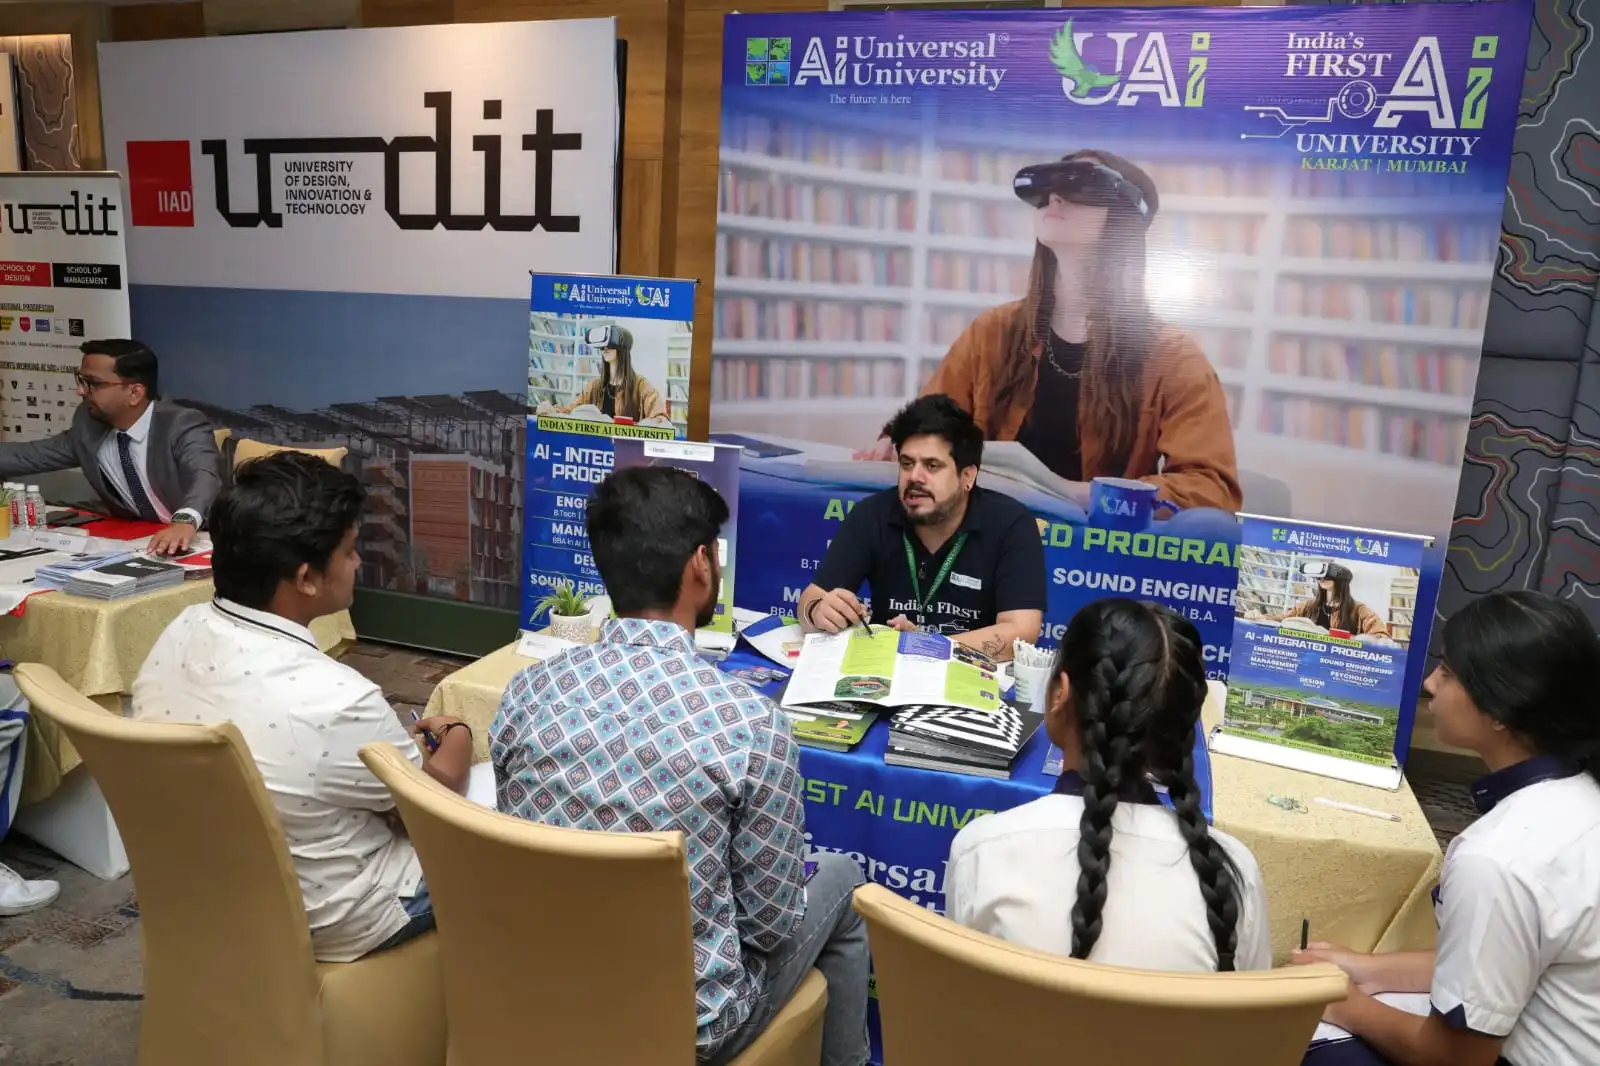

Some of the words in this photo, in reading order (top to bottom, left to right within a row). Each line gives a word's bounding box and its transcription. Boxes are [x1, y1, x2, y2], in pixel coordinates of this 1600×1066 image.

[853, 33, 997, 60] Universal
[1287, 32, 1365, 50] India's
[1284, 52, 1392, 78] FIRST
[853, 61, 1008, 92] University
[829, 93, 846, 104] The
[849, 93, 878, 105] future
[881, 94, 889, 104] is
[892, 94, 912, 105] here
[1296, 133, 1481, 156] UNIVERSITY
[284, 161, 353, 173] UNIVERSITY
[1301, 157, 1373, 171] KARJAT
[1386, 160, 1468, 173] MUMBAI
[284, 175, 300, 187] OF
[303, 175, 350, 188] DESIGN,
[158, 191, 191, 212] IIAD
[285, 189, 360, 201] INNOVATION
[363, 189, 372, 201] &
[286, 203, 366, 215] TECHNOLOGY
[66, 266, 92, 274] SCHOOL
[4, 274, 32, 282] DESIGN
[63, 276, 109, 285] MANAGEMENT
[587, 285, 631, 295] Universal
[587, 294, 634, 307] University
[540, 420, 573, 430] INDIA'S
[575, 422, 600, 434] FIRST
[602, 426, 613, 435] AI
[614, 427, 673, 440] UNIVERSITY
[533, 444, 549, 459] AI
[1306, 531, 1350, 544] Universal
[1305, 539, 1353, 554] University
[1053, 567, 1136, 593] SOUND
[936, 601, 981, 620] FIRST
[1189, 607, 1218, 623] B.A.
[1244, 631, 1255, 640] AI
[1263, 634, 1327, 652] INTEGRATED
[1330, 645, 1393, 664] PROGRAMS
[1253, 645, 1298, 658] ENGINEERING
[1250, 656, 1299, 669] MANAGEMENT
[1300, 677, 1325, 686] DESIGN
[855, 790, 884, 817] AI
